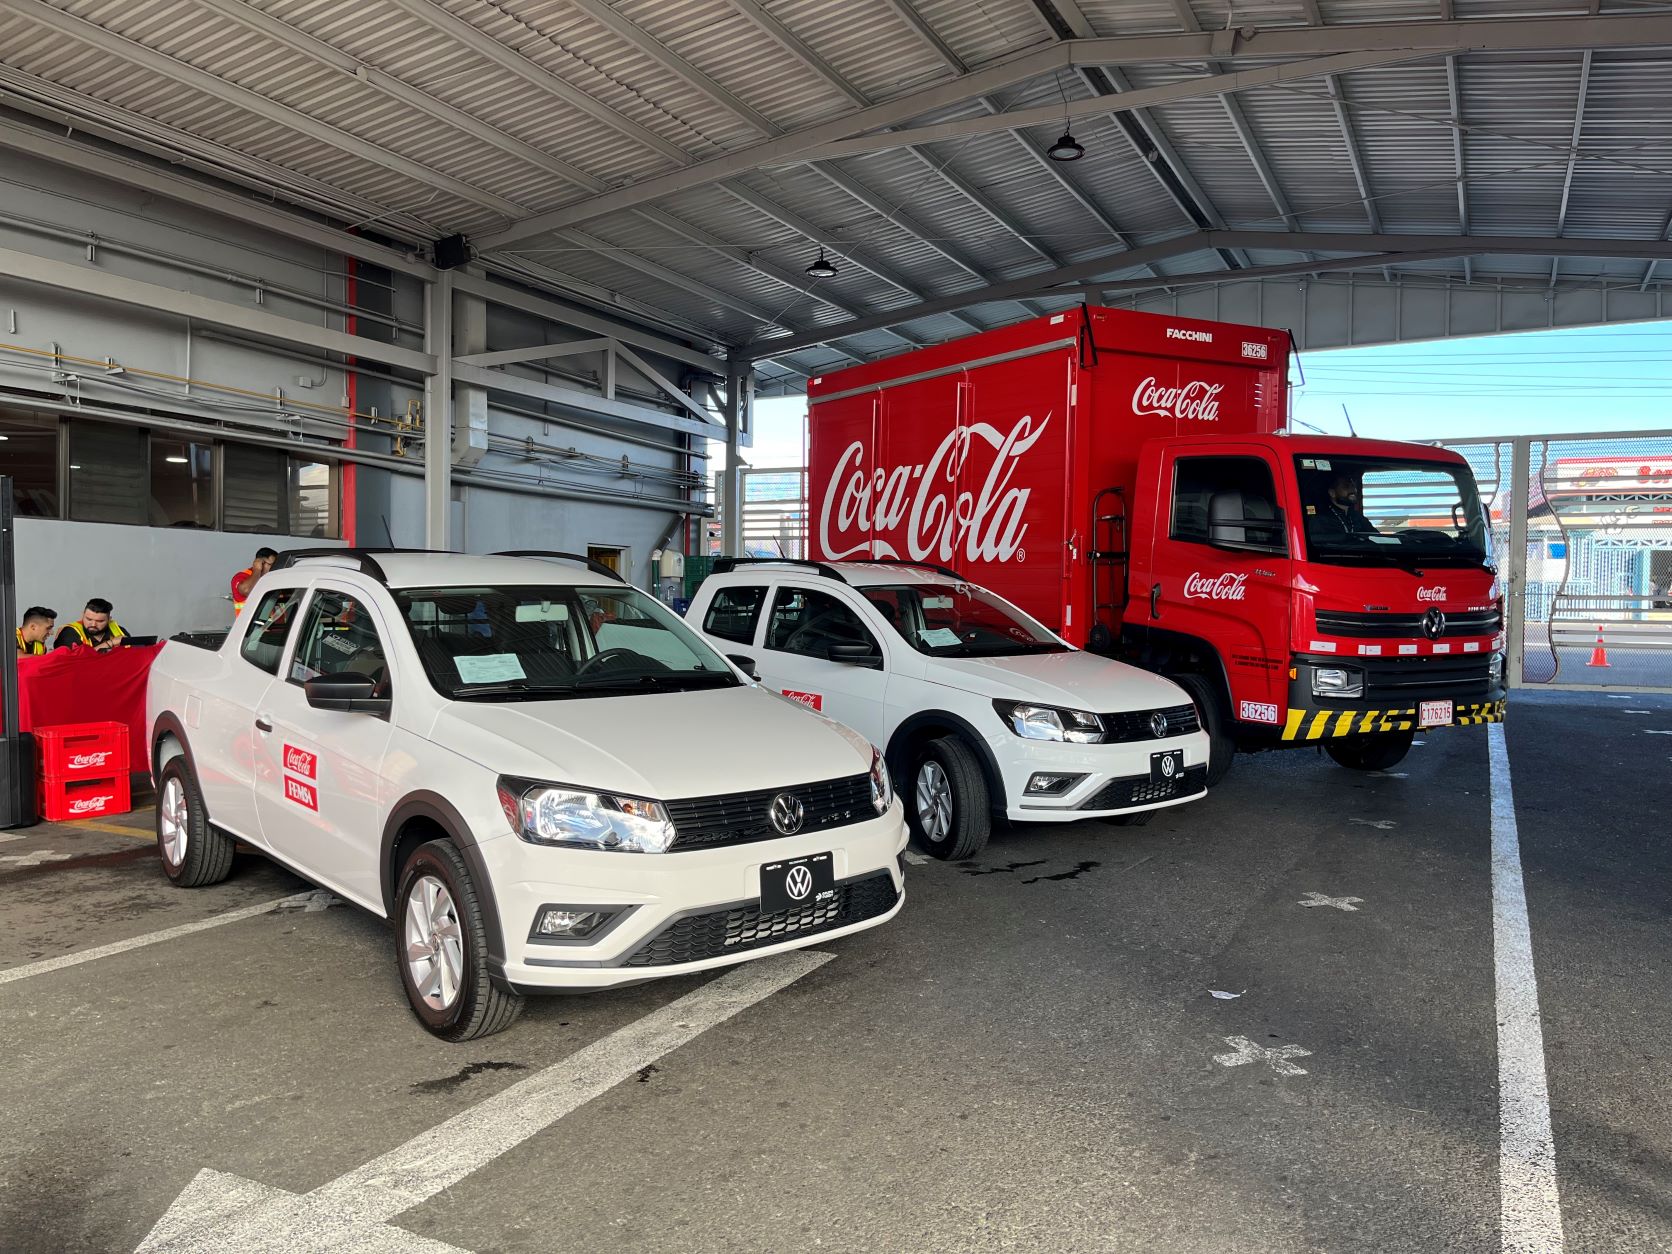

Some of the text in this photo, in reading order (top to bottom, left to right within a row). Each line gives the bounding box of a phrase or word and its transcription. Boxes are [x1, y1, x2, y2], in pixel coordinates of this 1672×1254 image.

[1166, 328, 1213, 343] FACCHINI
[1242, 343, 1266, 359] 36256
[1132, 376, 1225, 421] Coca-Cola
[820, 410, 1052, 563] Coca-Cola
[1183, 572, 1249, 600] Coca-Cola
[1417, 586, 1447, 601] Coca-Cola
[1242, 702, 1275, 721] 36256
[287, 748, 312, 776] Coca-Cola
[288, 780, 314, 806] FEMSA
[786, 866, 812, 900] VW
